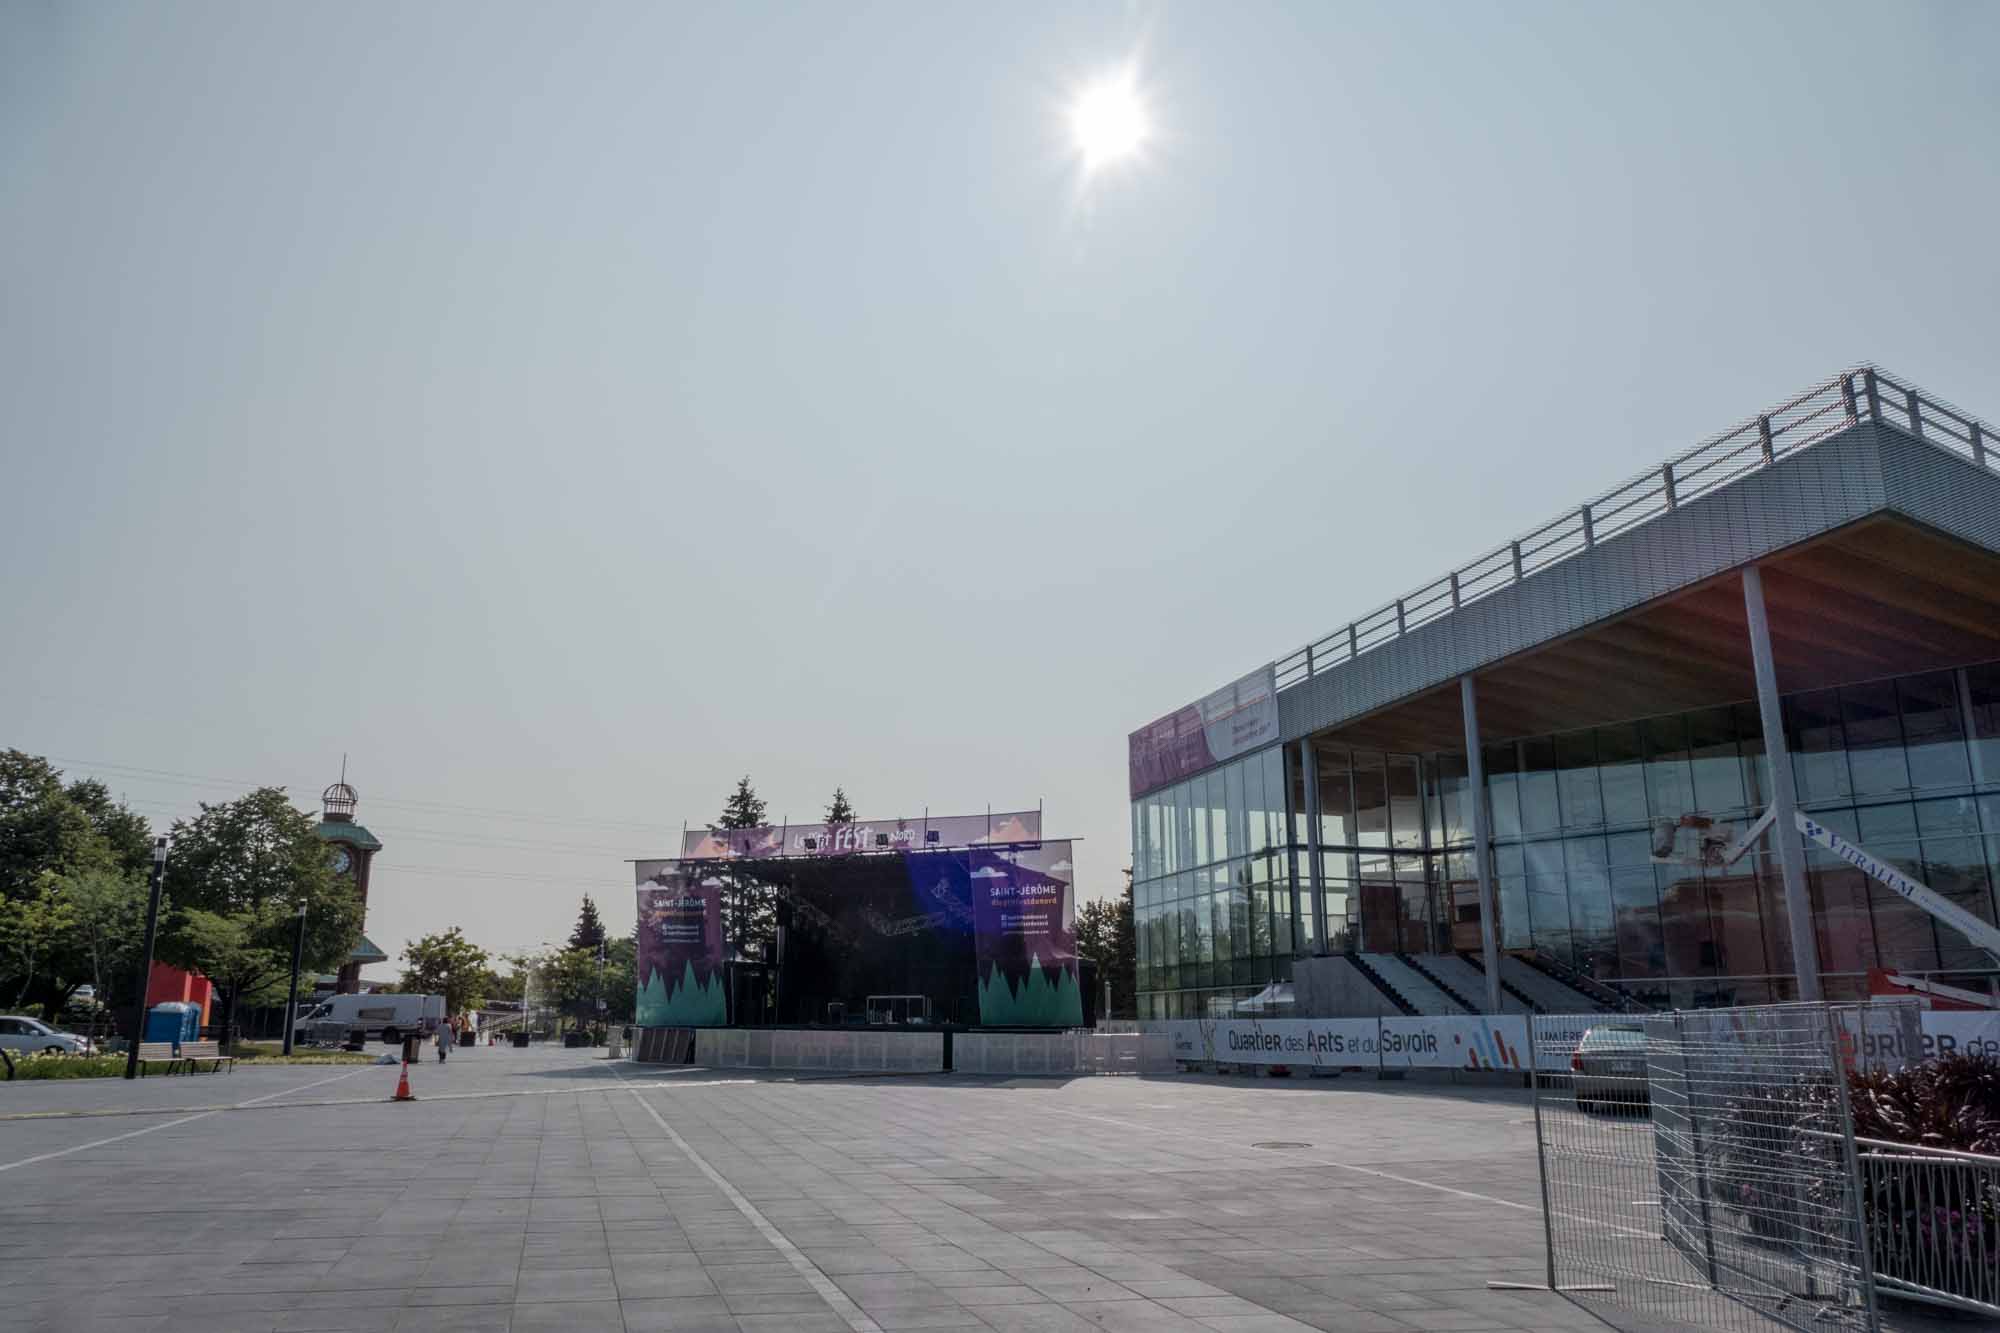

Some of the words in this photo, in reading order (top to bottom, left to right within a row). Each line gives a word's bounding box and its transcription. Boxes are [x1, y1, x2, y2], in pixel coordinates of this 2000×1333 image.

[1829, 832, 1917, 898] VITRALUM
[990, 883, 1057, 897] SAINT-JÉRÔME
[1284, 1034, 1304, 1052] des
[1307, 1030, 1345, 1053] Arts
[1347, 1035, 1360, 1053] et
[1362, 1036, 1379, 1053] du
[1381, 1029, 1438, 1053] Savoir
